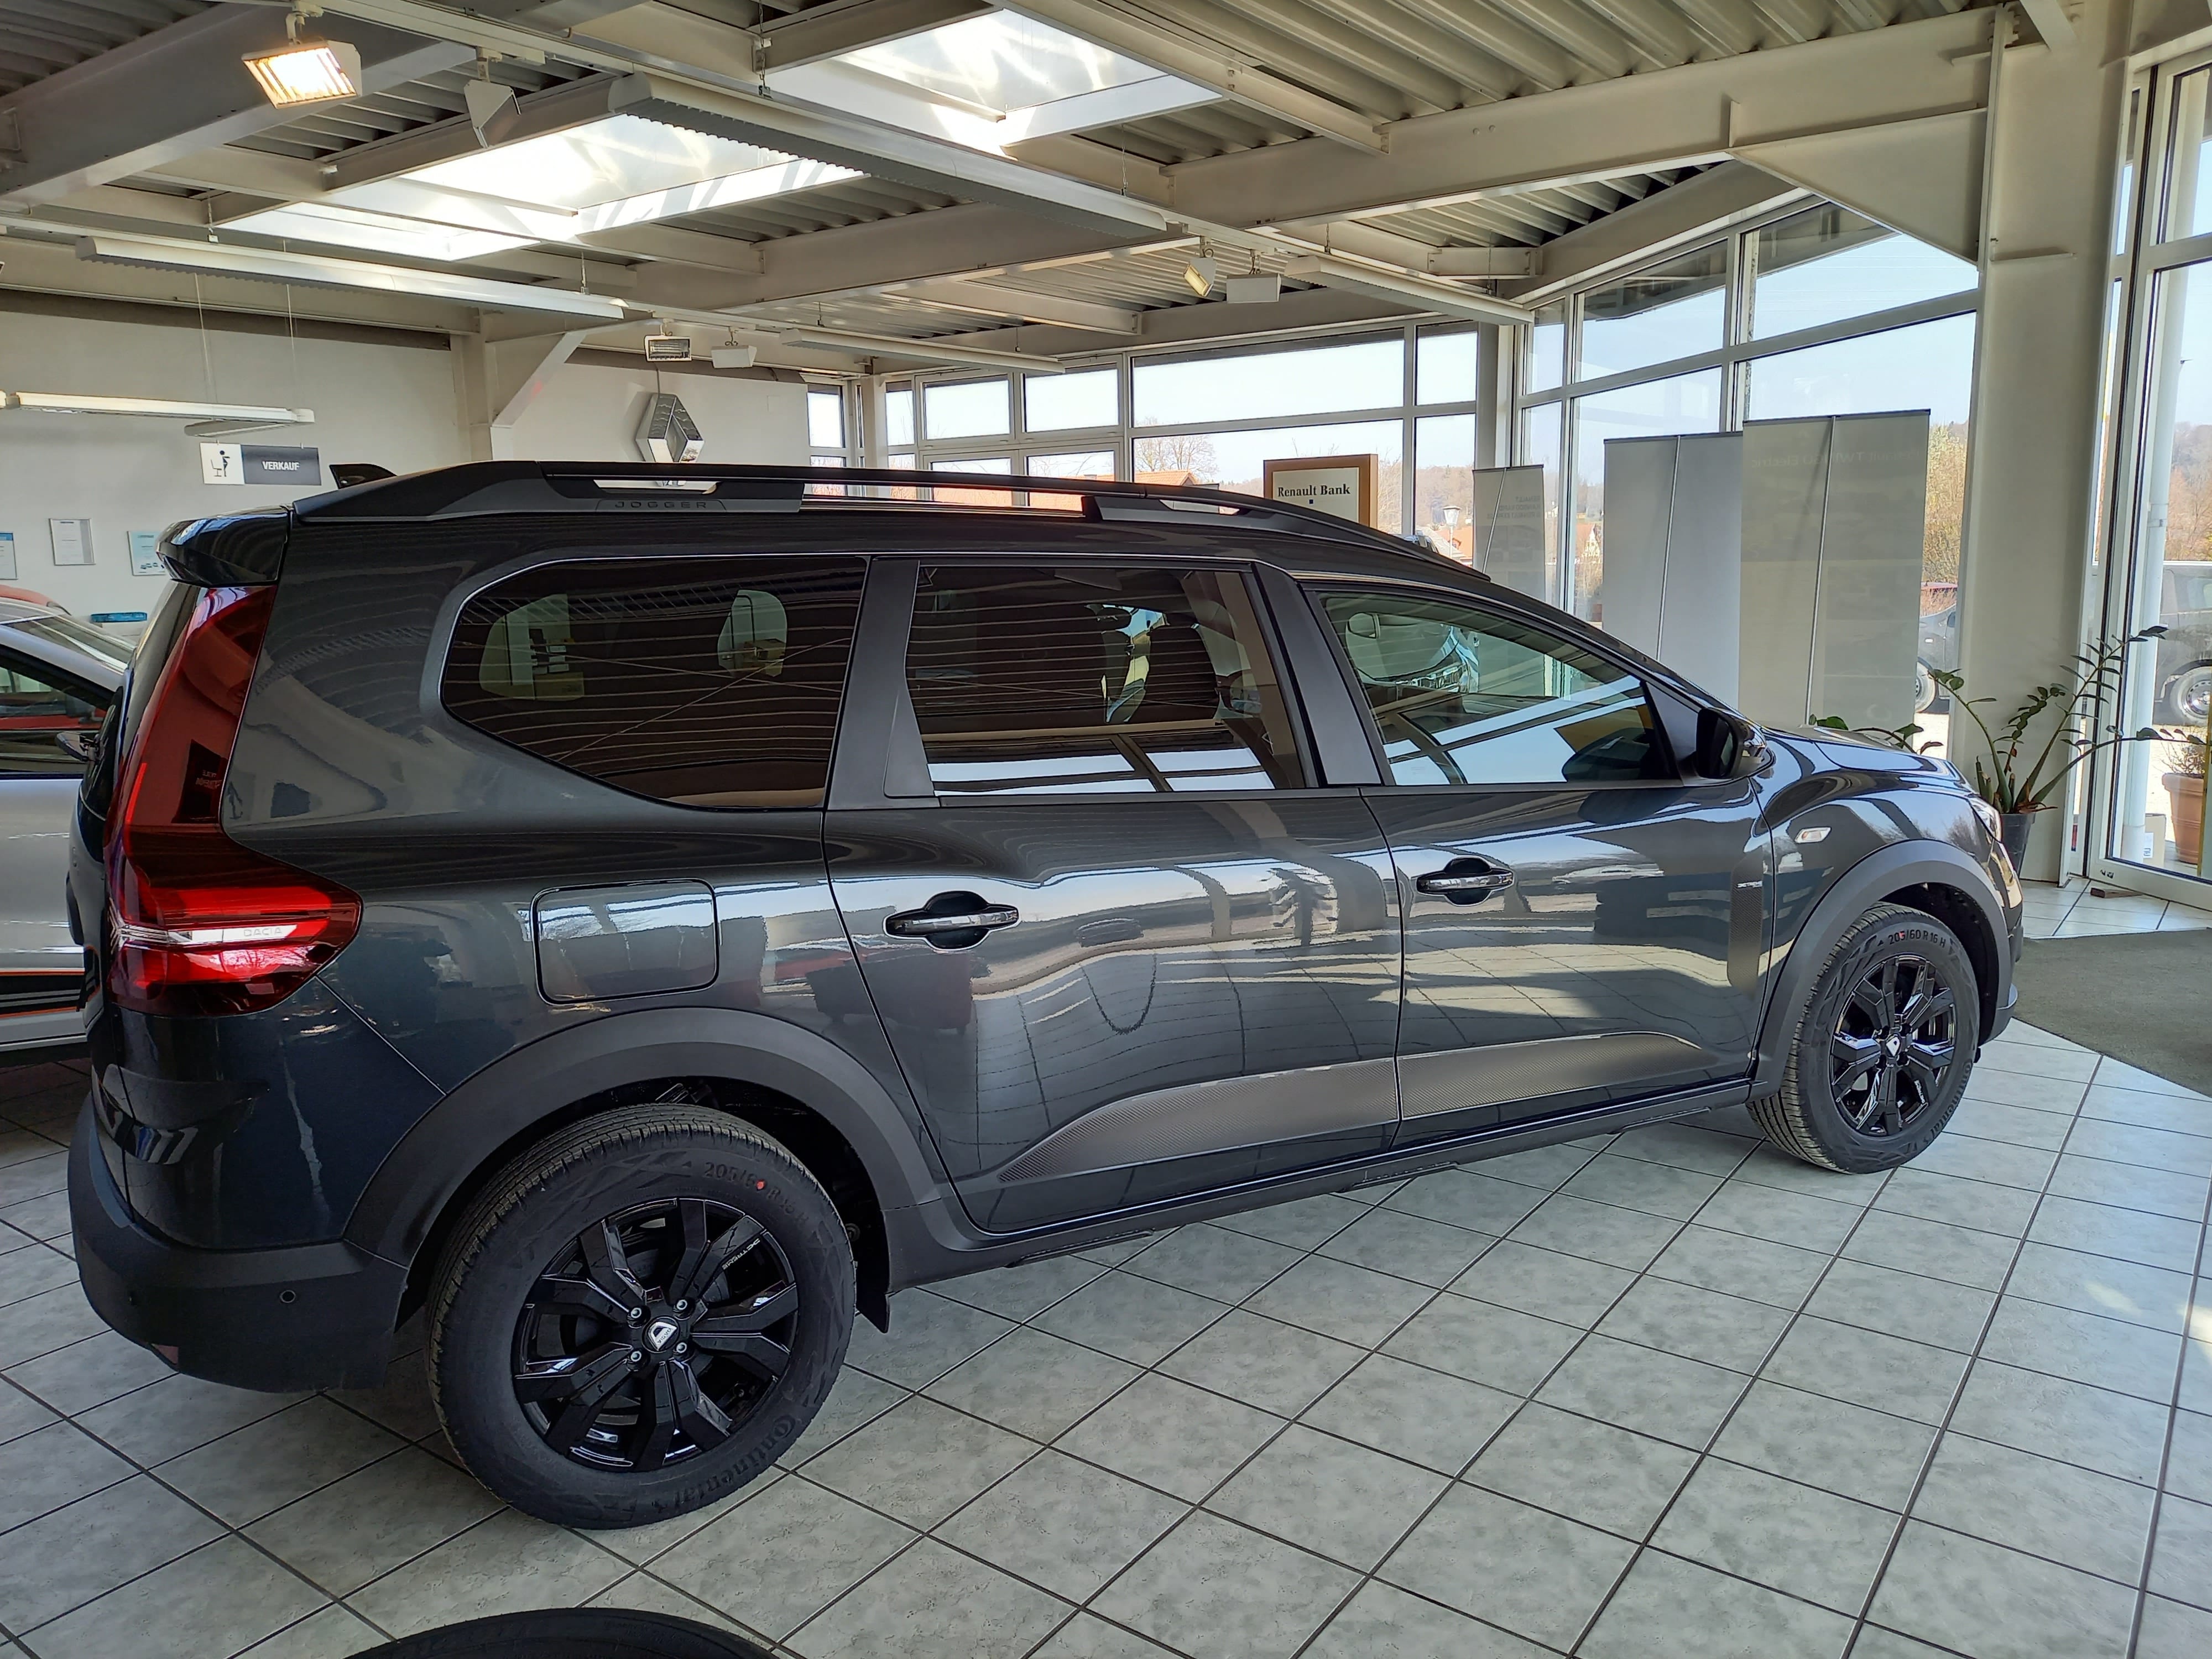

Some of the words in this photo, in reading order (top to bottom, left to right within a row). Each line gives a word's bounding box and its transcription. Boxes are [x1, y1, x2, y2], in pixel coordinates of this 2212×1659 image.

[262, 461, 300, 471] VERKAUF
[1278, 484, 1317, 497] Renault
[1320, 483, 1350, 495] Bank
[243, 927, 282, 937] DACIA
[1922, 930, 1929, 940] R
[1930, 932, 1938, 943] 16
[1939, 937, 1947, 948] H
